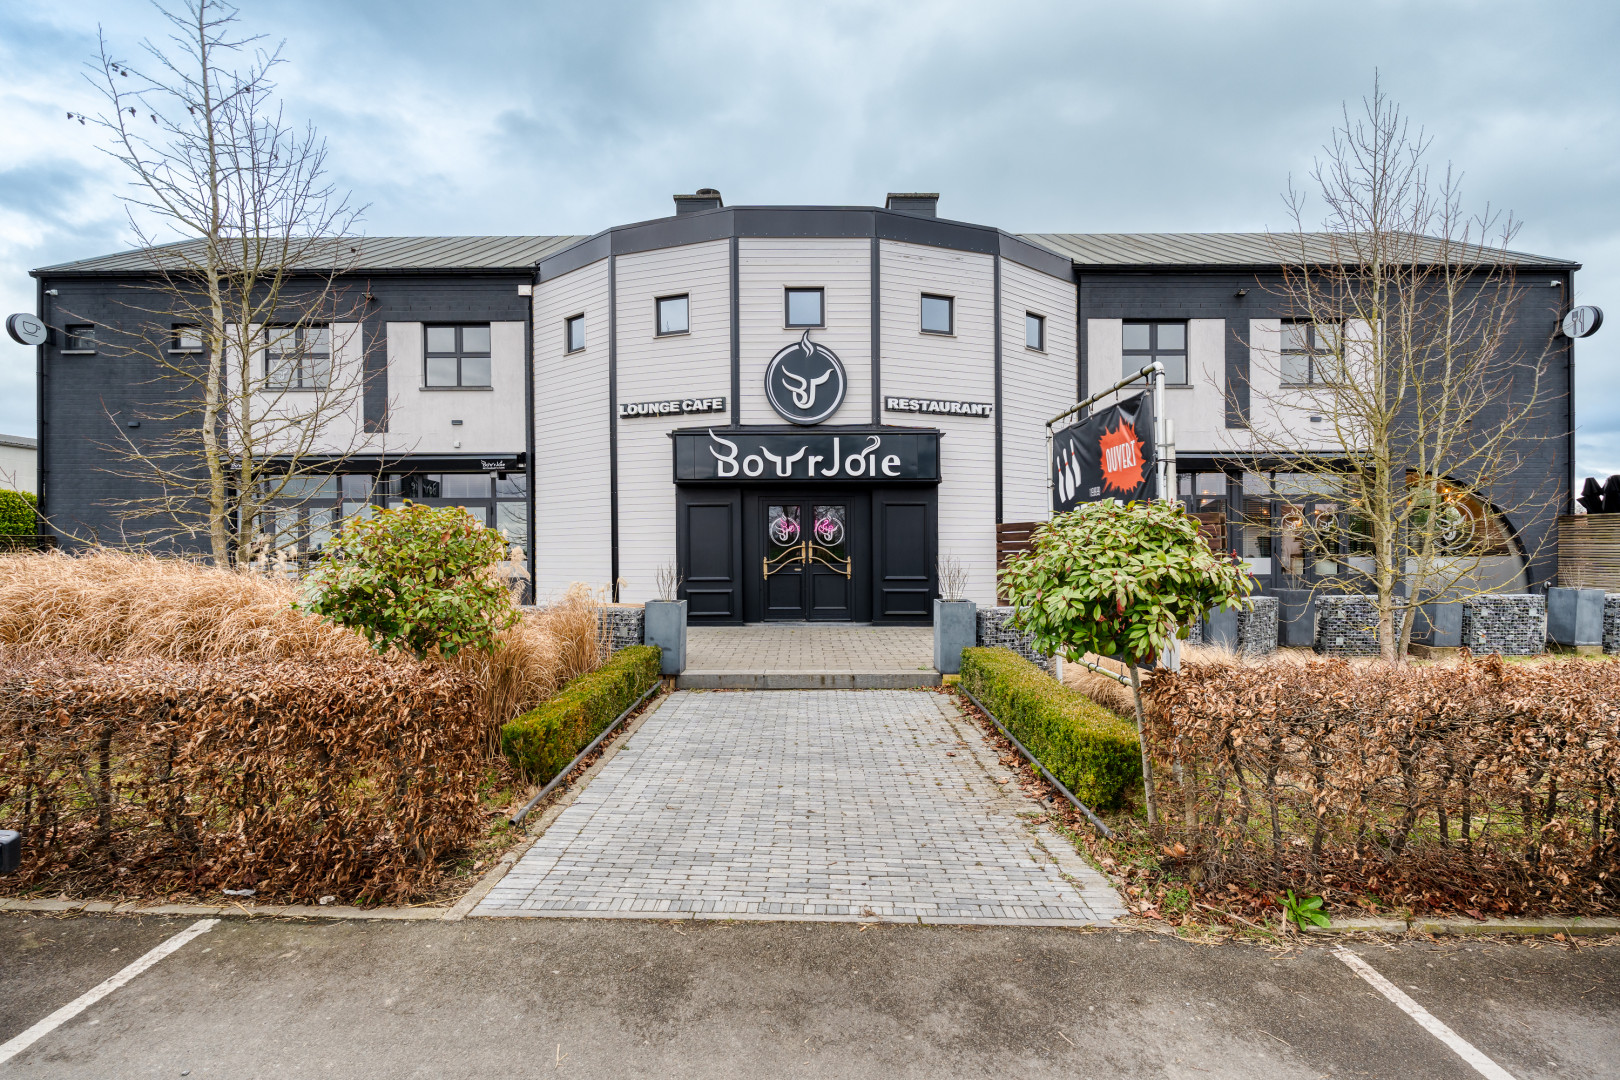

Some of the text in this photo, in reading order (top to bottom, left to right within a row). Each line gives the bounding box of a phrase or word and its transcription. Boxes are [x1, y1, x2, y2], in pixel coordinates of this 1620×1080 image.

[619, 398, 723, 416] LOUNGE CAFE
[887, 398, 992, 415] RESTAURANT
[1105, 440, 1136, 473] OUVERT
